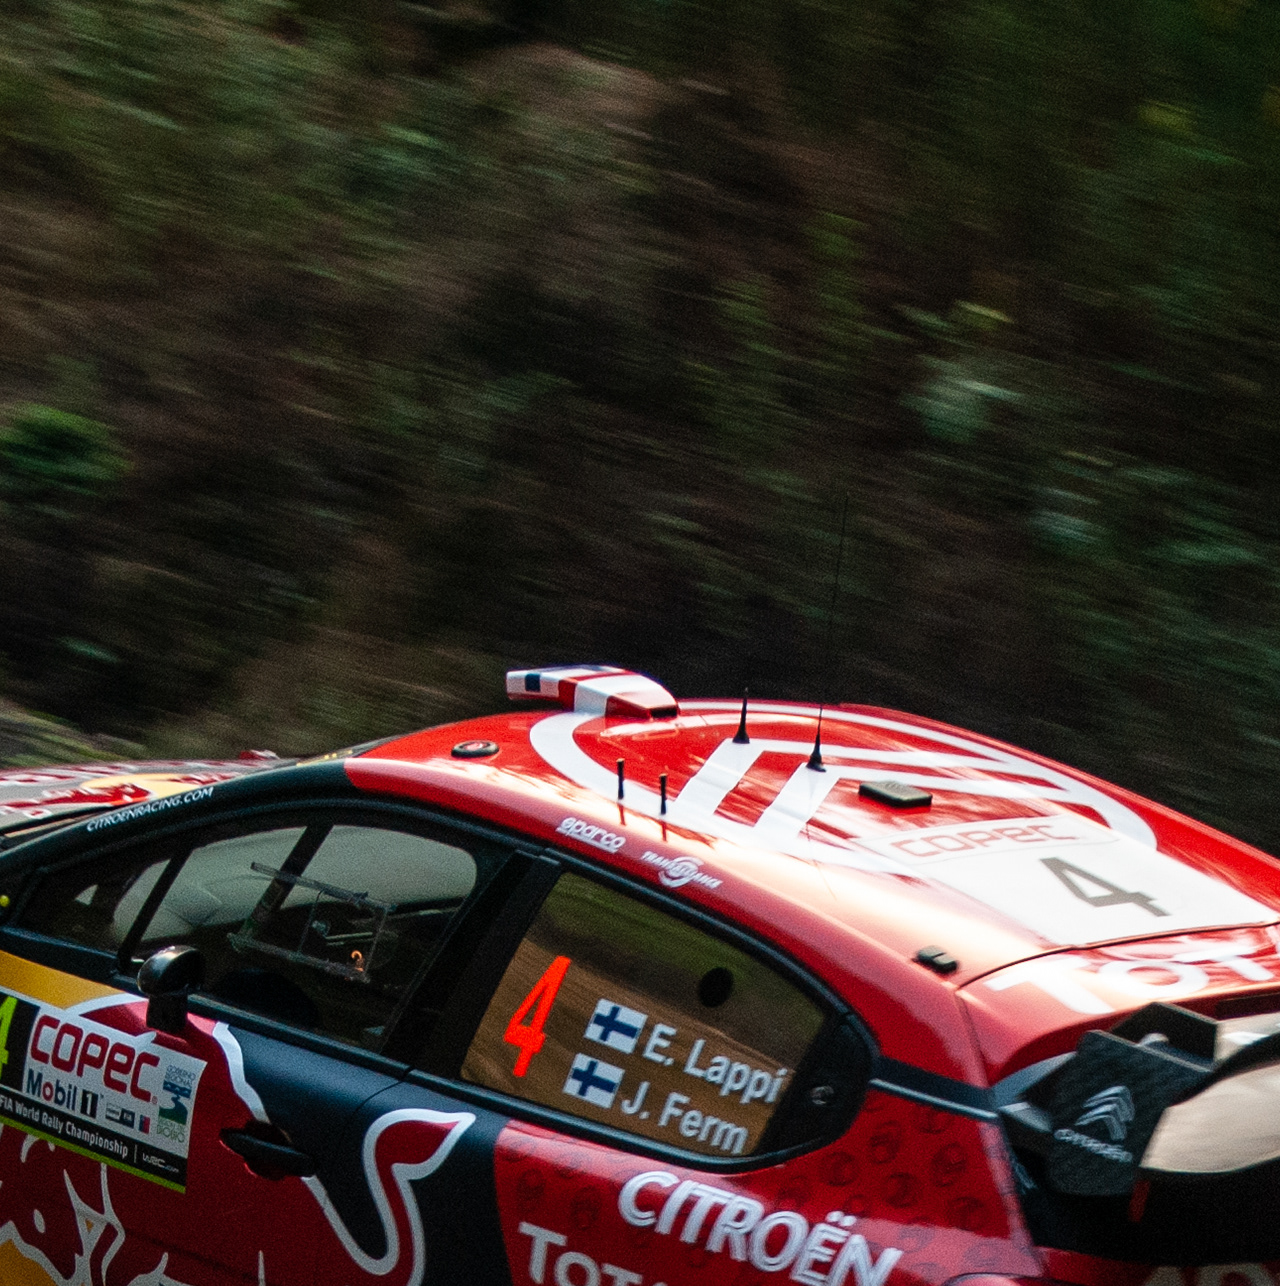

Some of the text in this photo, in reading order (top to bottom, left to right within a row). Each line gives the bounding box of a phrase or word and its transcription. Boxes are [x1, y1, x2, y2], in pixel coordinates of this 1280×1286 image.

[1039, 857, 1172, 917] 4
[503, 955, 572, 1077] 4
[26, 1068, 77, 1111] Mobil
[82, 1090, 96, 1116] 1
[642, 1023, 788, 1104] E. Lappi
[14, 1100, 40, 1122] World
[41, 1109, 65, 1134] Rally
[65, 1117, 129, 1159] Championship
[621, 1080, 749, 1155] J. Ferm
